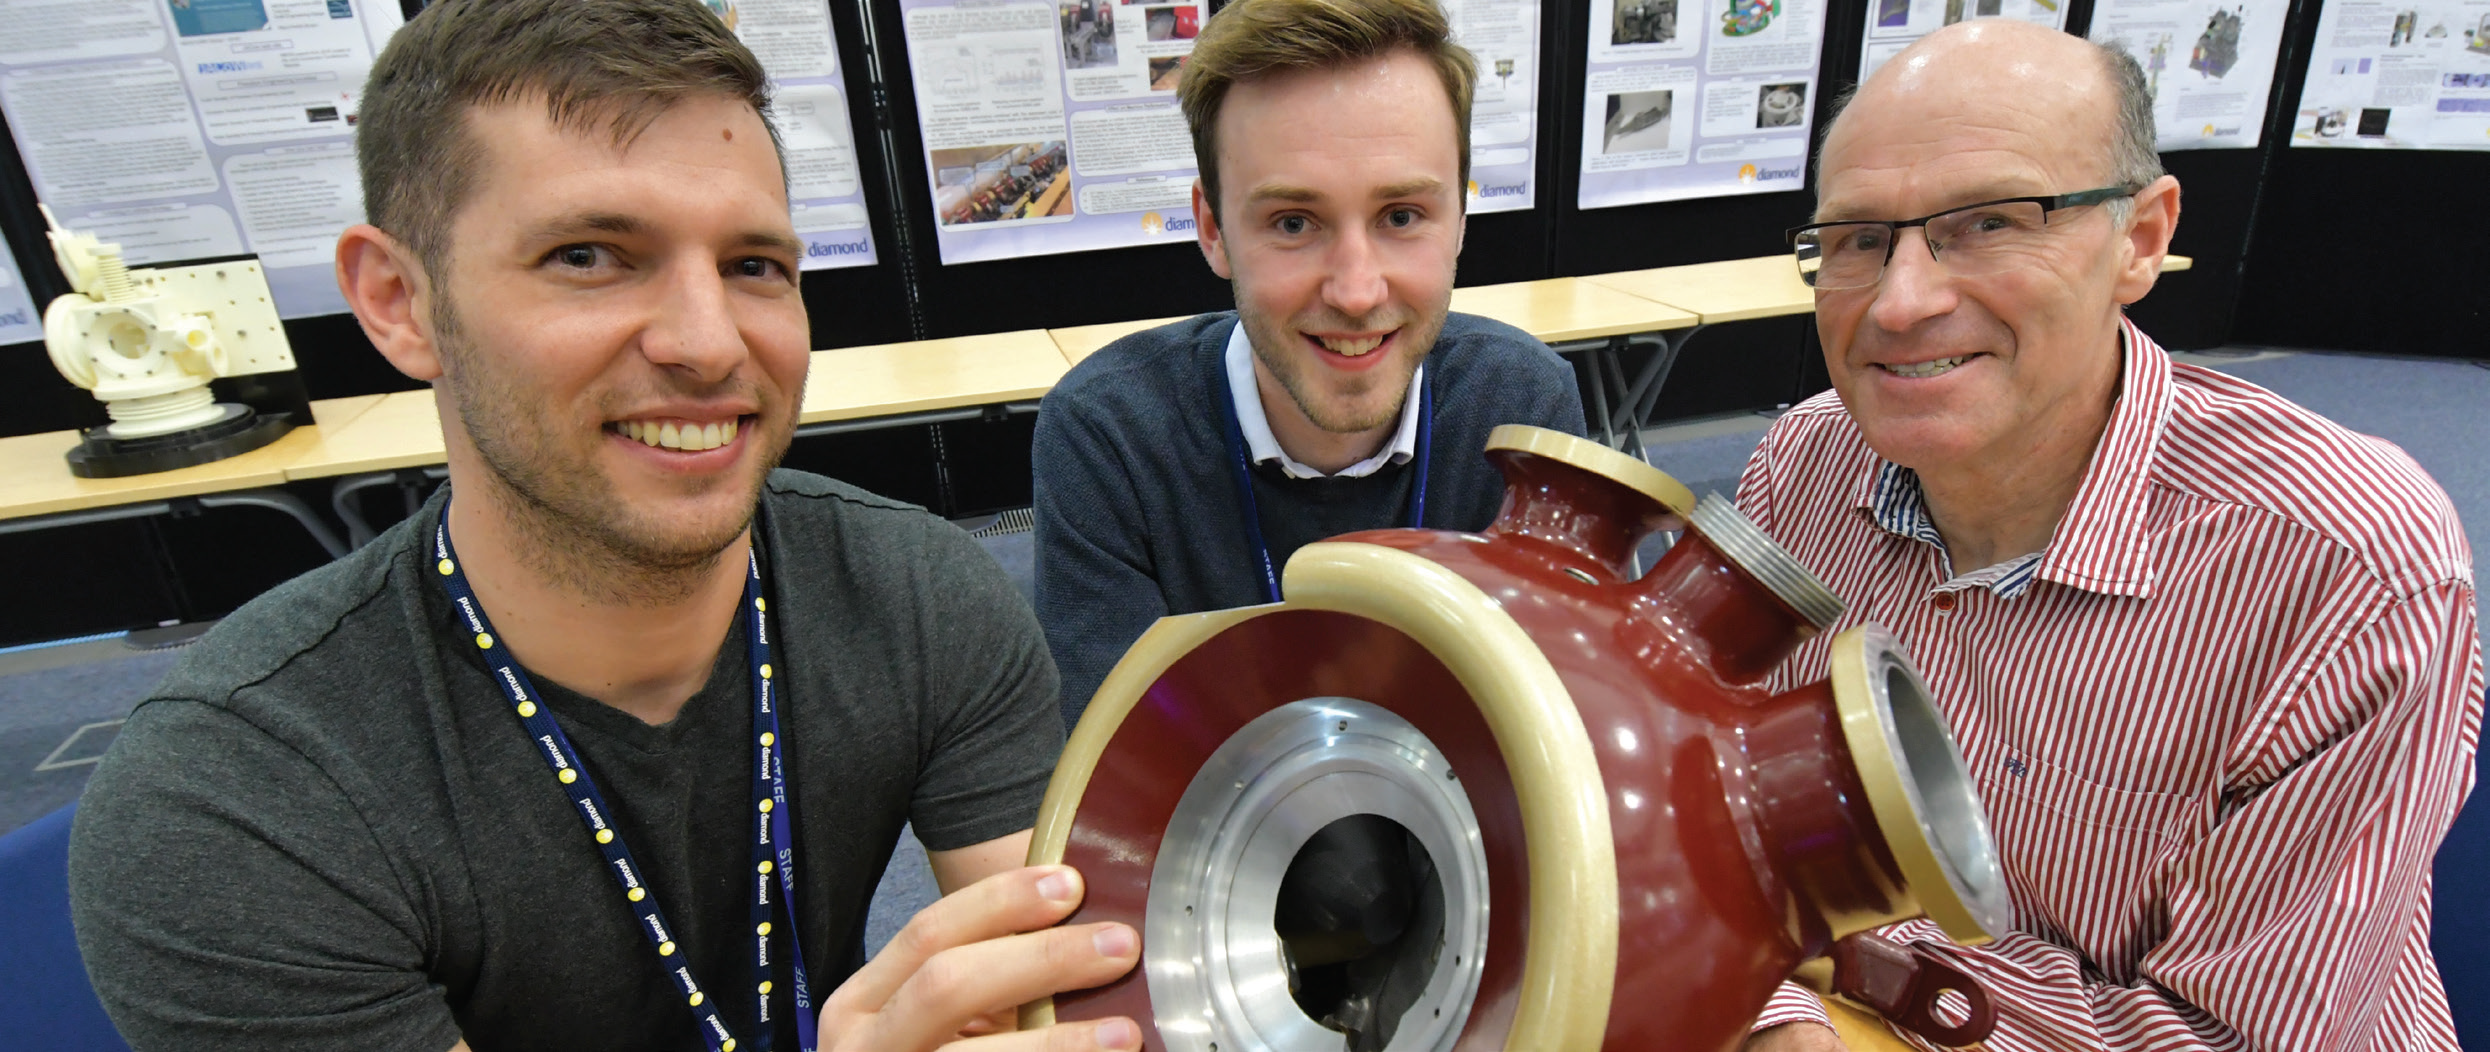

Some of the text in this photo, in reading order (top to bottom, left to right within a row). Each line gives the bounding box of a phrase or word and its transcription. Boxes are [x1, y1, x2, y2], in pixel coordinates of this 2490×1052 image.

[1757, 165, 1800, 181] diamond
[1480, 181, 1526, 198] diamond
[1165, 215, 1195, 232] diam
[808, 237, 869, 257] diamond
[457, 596, 485, 633] diamond
[759, 610, 769, 645] diamond
[499, 666, 528, 703] diamond
[762, 679, 771, 713] diamond
[540, 734, 569, 770] diamond
[762, 747, 771, 780] diamond
[580, 798, 606, 829] diamond
[760, 813, 770, 844] diamond
[614, 858, 639, 888] diamond
[779, 848, 794, 892] STAFF
[759, 874, 769, 904] diamond
[645, 914, 669, 942] diamond
[760, 936, 769, 966] diamond
[676, 967, 698, 994] diamond
[794, 967, 810, 1009] STAFF
[760, 995, 770, 1022] diamond
[706, 1014, 730, 1042] diamond
